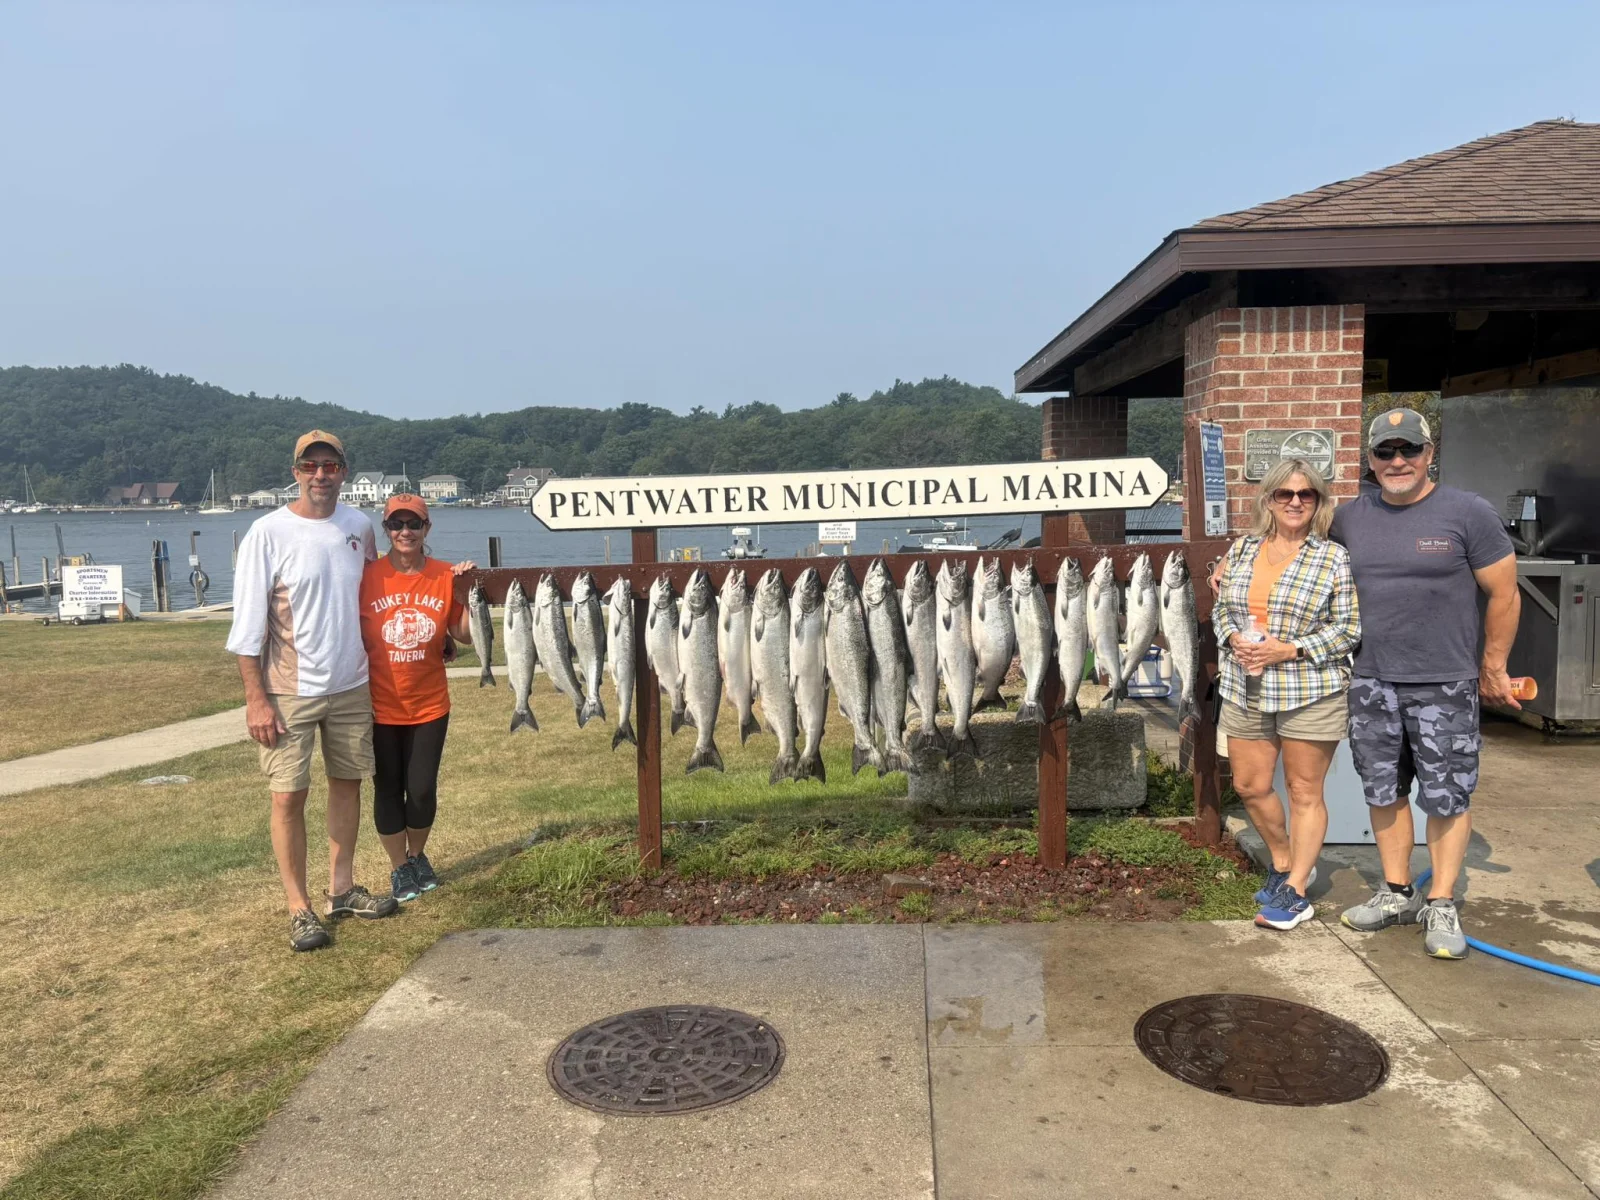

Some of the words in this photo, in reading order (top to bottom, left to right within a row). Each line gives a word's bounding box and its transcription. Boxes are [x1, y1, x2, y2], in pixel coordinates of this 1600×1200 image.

[549, 486, 769, 518] PENTWATER
[782, 477, 989, 511] MUNICIPAL
[1002, 470, 1152, 502] MARINA
[370, 592, 410, 613] ZUKEY
[414, 593, 444, 612] LAKE
[388, 650, 426, 662] TAVERN
